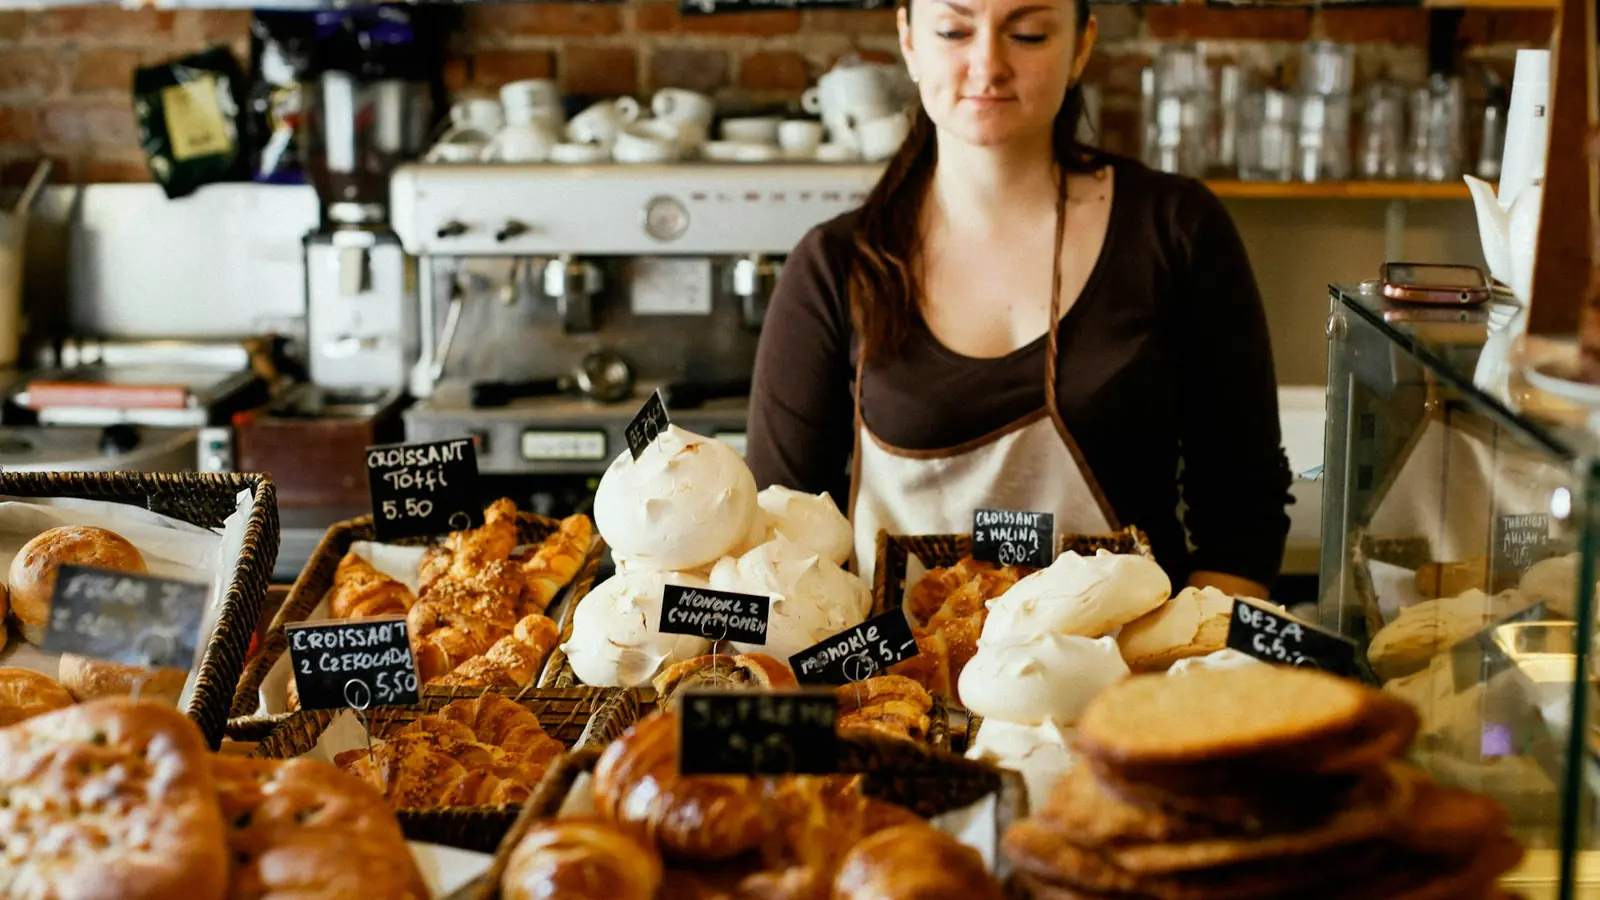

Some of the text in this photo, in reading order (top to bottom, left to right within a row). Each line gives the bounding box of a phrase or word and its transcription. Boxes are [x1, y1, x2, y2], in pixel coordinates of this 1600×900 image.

[367, 440, 468, 469] CROISSANT
[382, 497, 433, 520] 5.50
[976, 511, 1041, 528] CROISSANT
[293, 622, 406, 651] CROISSANT
[376, 670, 417, 702] 5,50
